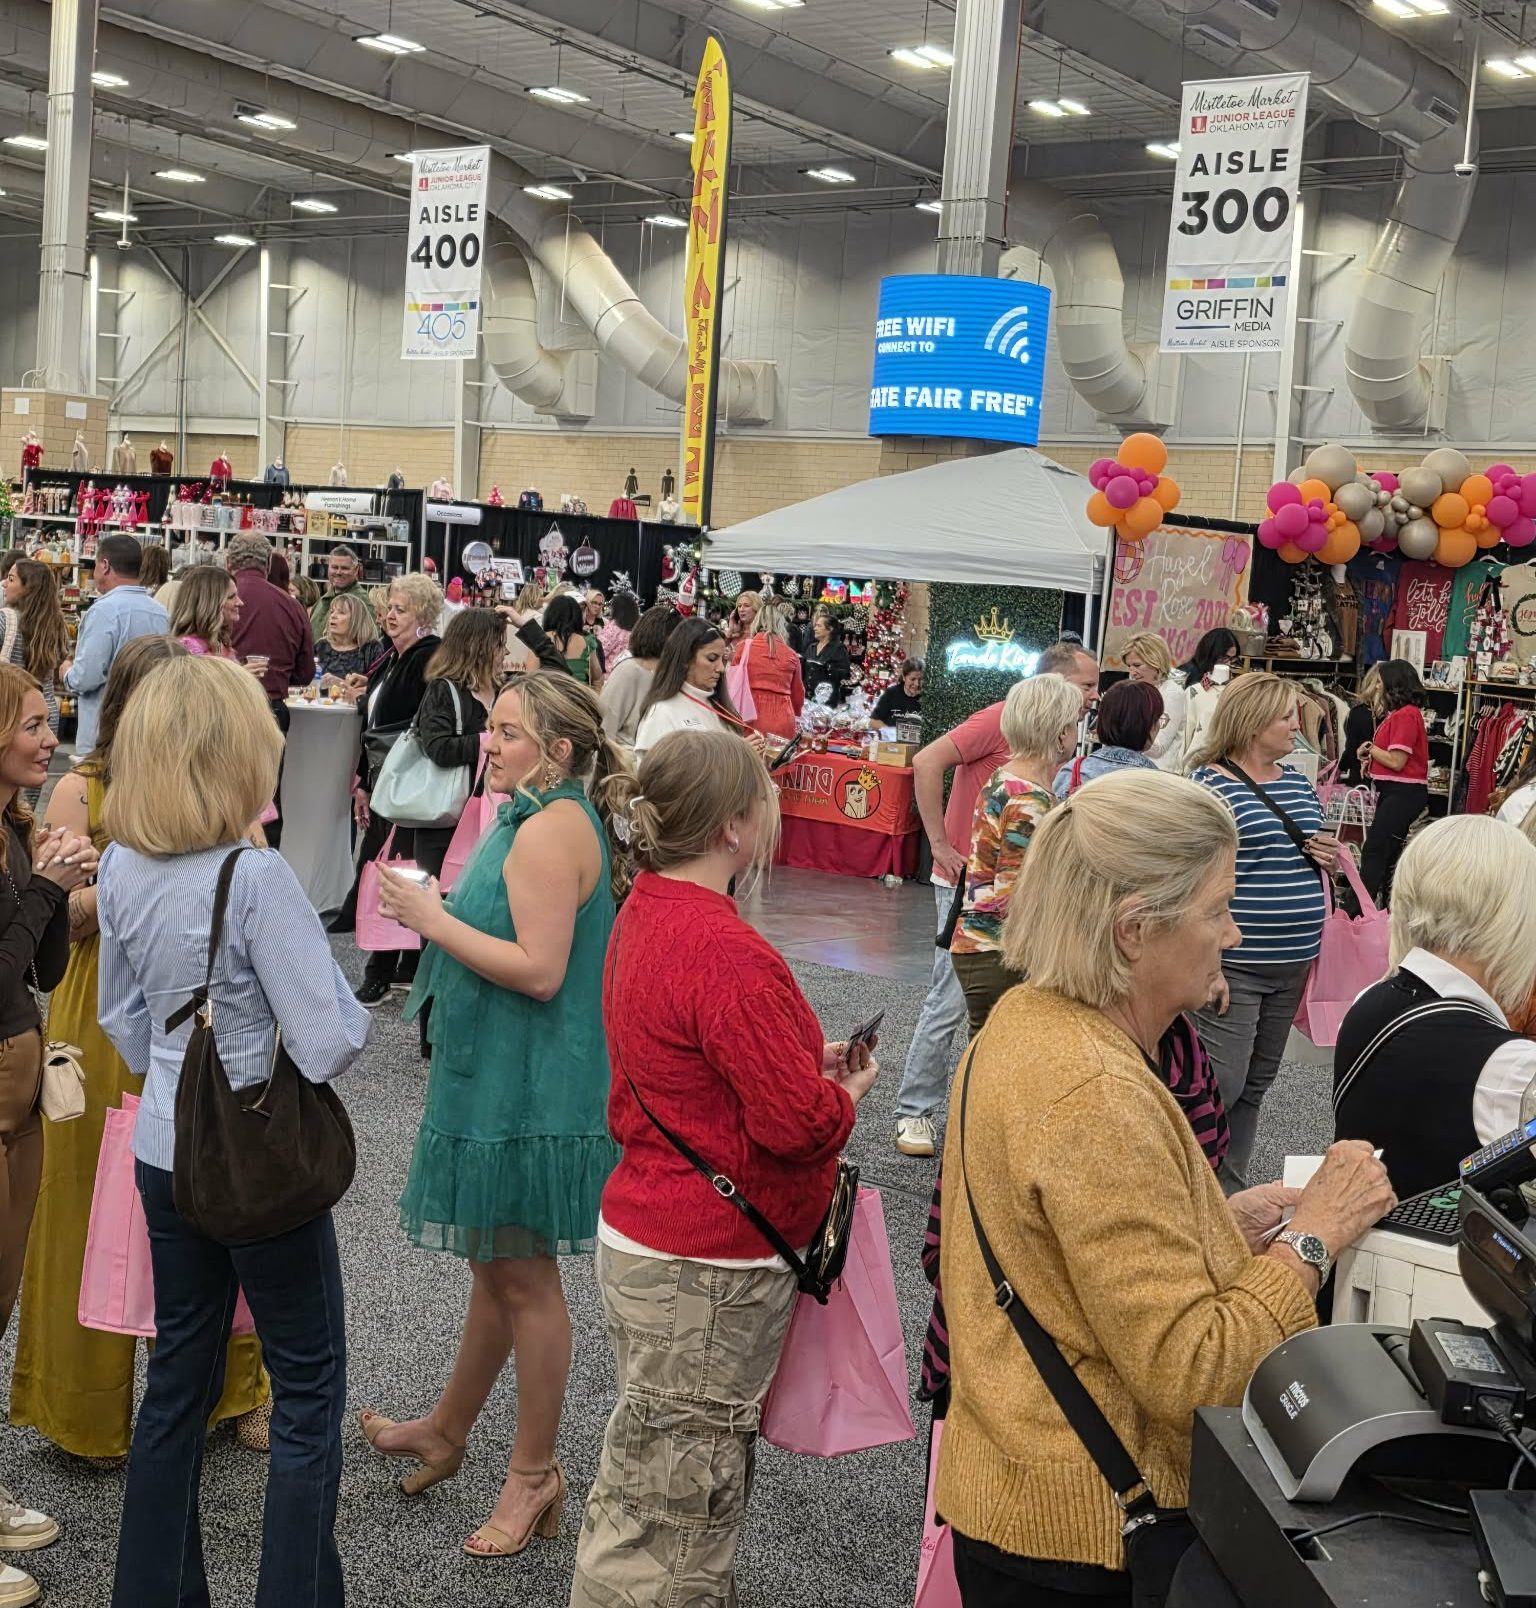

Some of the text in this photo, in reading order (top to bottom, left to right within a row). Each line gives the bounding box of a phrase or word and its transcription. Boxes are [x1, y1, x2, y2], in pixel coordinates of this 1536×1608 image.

[1190, 86, 1299, 113] Mistletoe Market
[1209, 120, 1289, 133] OKLAHOMA CITY
[1210, 109, 1295, 123] JUNIOR LEAGUE
[1189, 148, 1289, 177] AISLE
[431, 173, 481, 184] JUNIOR LEAGUE
[419, 203, 478, 225] AISLE
[1176, 186, 1289, 235] 300
[410, 232, 479, 269] 400
[1177, 297, 1274, 320] GRIFFIN
[417, 312, 466, 340] 405
[906, 316, 956, 337] WIFI
[1234, 321, 1271, 332] MEDIA
[878, 340, 935, 353] CONNECT TO
[1210, 340, 1235, 348] AISLE
[1237, 338, 1280, 348] SPONSOR
[904, 386, 963, 410] FAIR
[1148, 539, 1213, 592] Hazel
[1111, 588, 1158, 629] EST
[1159, 577, 1194, 623] Rose
[1280, 1393, 1298, 1420] ORACLE
[1289, 1381, 1310, 1408] micros
